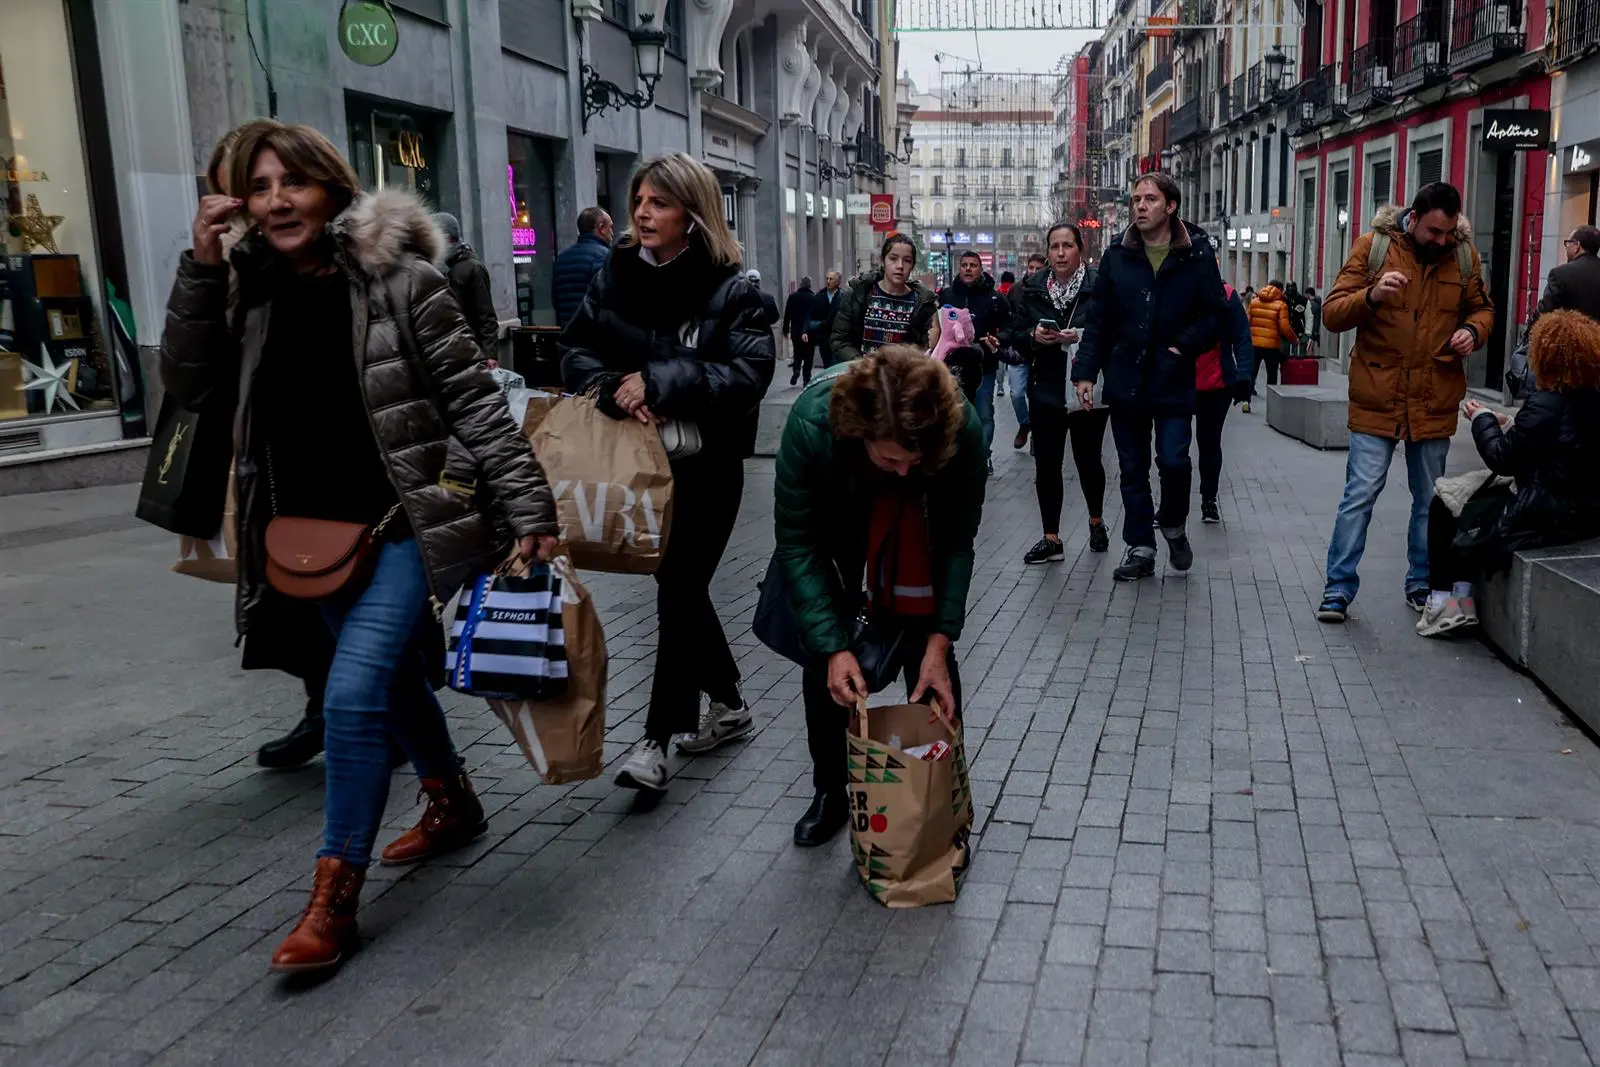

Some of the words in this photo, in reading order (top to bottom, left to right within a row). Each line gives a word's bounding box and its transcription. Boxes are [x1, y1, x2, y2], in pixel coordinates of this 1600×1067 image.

[347, 23, 387, 46] CXC
[398, 130, 425, 169] CXC
[492, 610, 537, 622] SEPHORA
